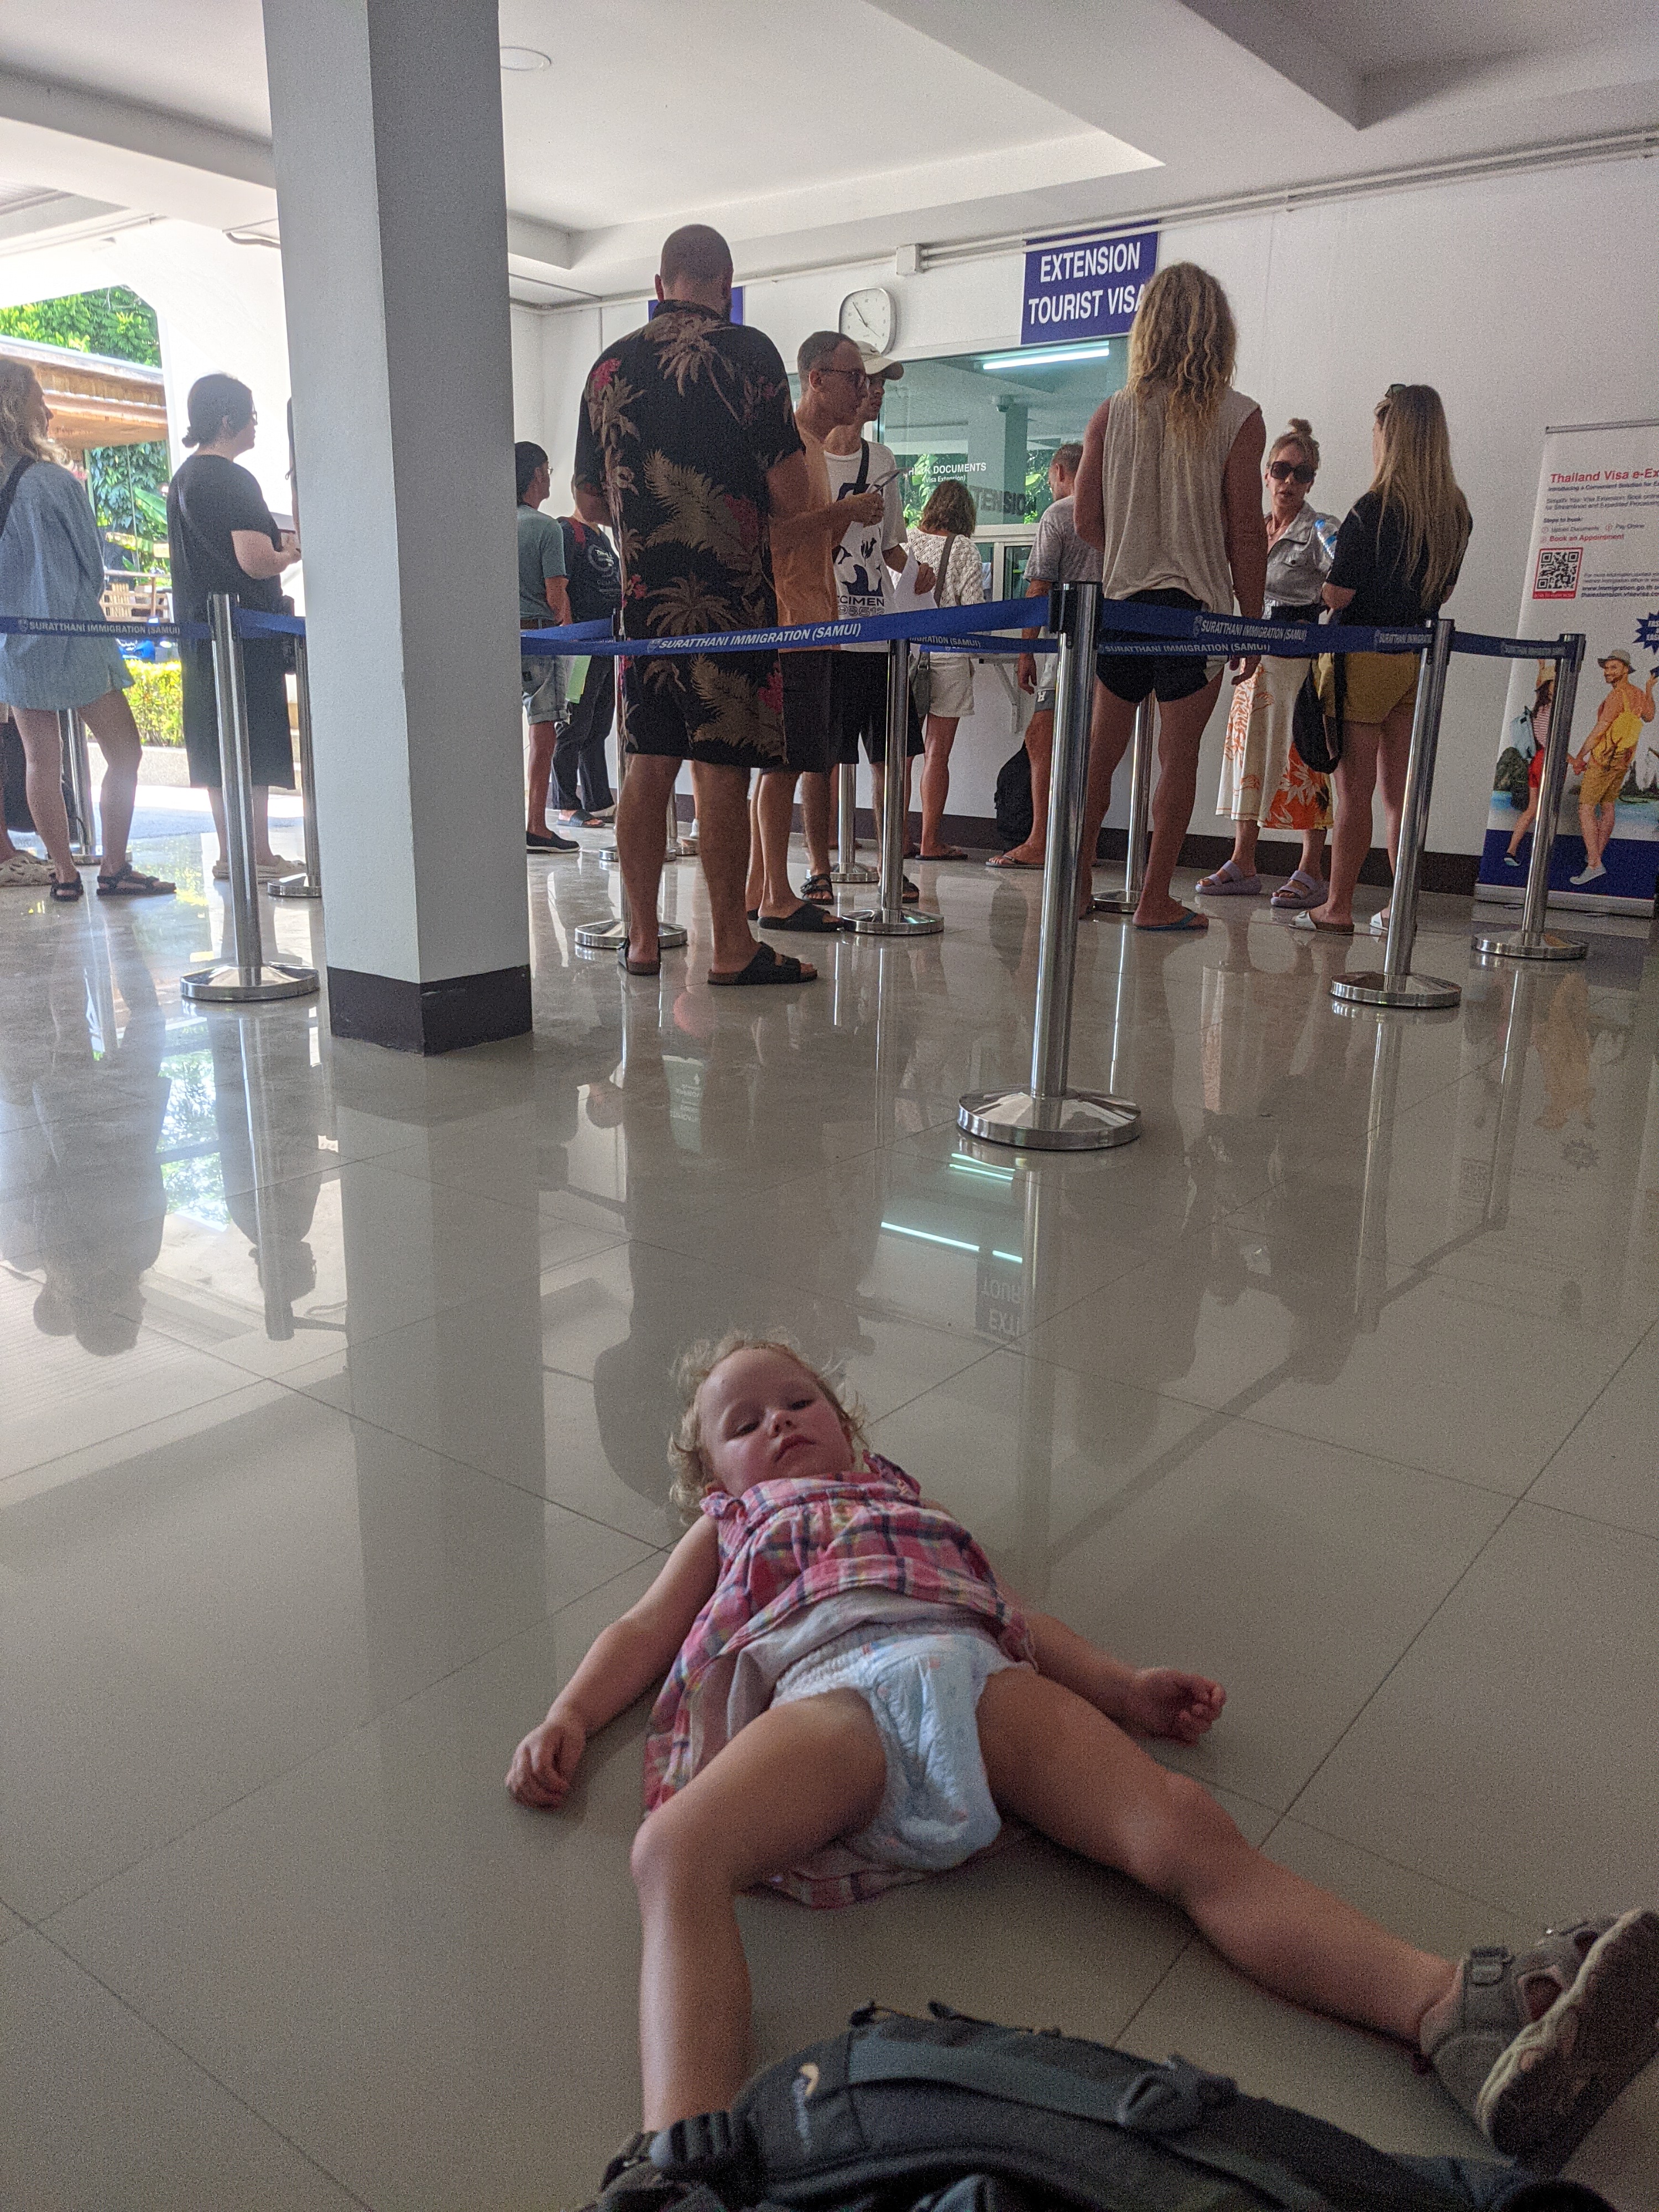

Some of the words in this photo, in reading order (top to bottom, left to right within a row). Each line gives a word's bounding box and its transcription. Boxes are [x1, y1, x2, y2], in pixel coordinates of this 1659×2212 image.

[1040, 242, 1140, 283] EXTENSION
[1028, 290, 1103, 325] TOURIST
[933, 462, 987, 474] DOCUMENTS
[1551, 471, 1600, 483] Thailand
[1604, 470, 1629, 480] Visa
[1580, 534, 1625, 542] Appointment
[837, 595, 885, 607] CIMEN
[87, 622, 146, 634] IMMIGRATION
[1201, 619, 1242, 636] SURATTHANI
[1243, 624, 1284, 640] IMMIGRATION
[660, 636, 729, 649] SURATTHANI
[731, 629, 811, 645] IMMIGRATION
[812, 623, 861, 641] (SAMUI)
[950, 638, 981, 648] (SAMUI)
[1105, 644, 1161, 653] SURATTHANI
[1164, 643, 1229, 653] IMMIGRATION
[1231, 643, 1270, 653] (SAMUI)
